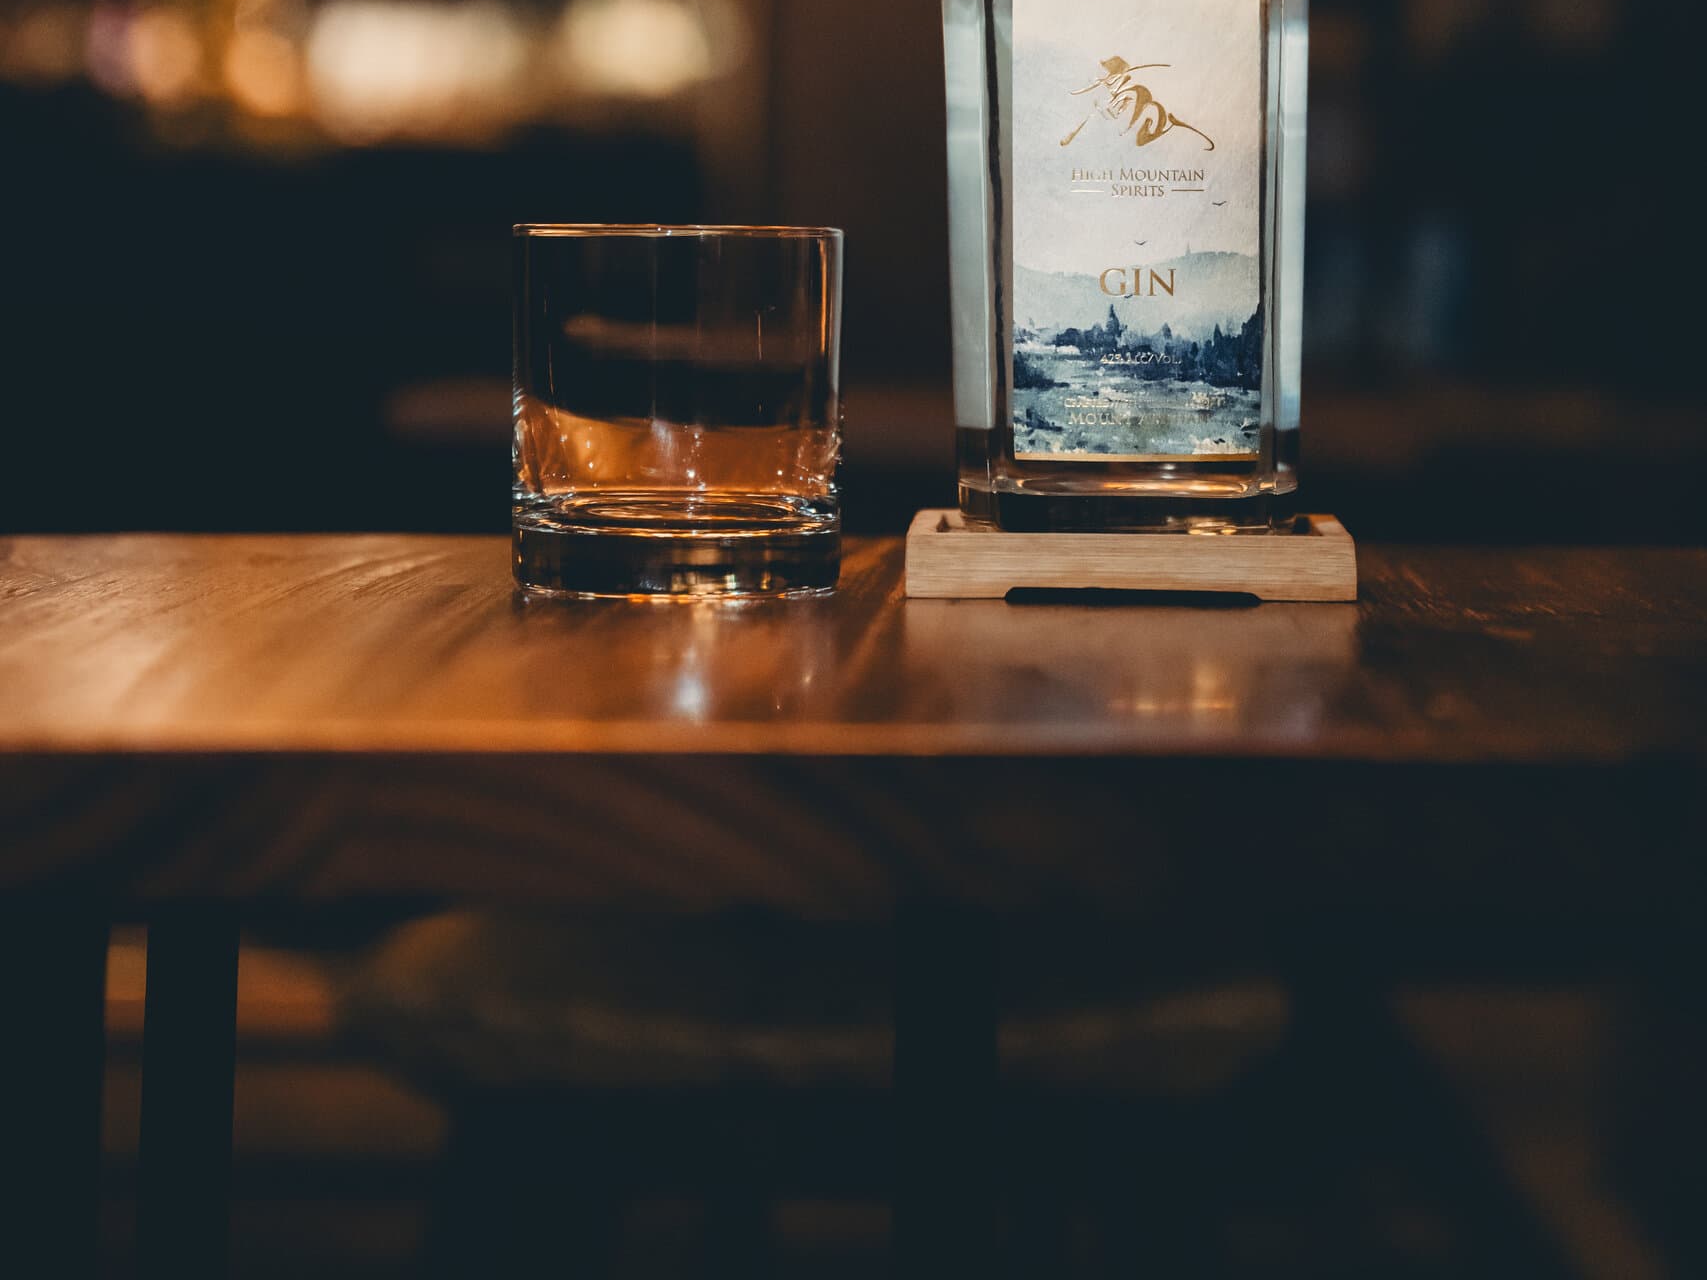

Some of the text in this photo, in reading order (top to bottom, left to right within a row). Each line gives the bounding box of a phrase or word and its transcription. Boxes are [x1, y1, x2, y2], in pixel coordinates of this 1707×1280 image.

[1071, 168, 1204, 181] HIGH MOUNTAIN
[1111, 184, 1165, 197] SPIRITS
[1099, 268, 1177, 297] GIN
